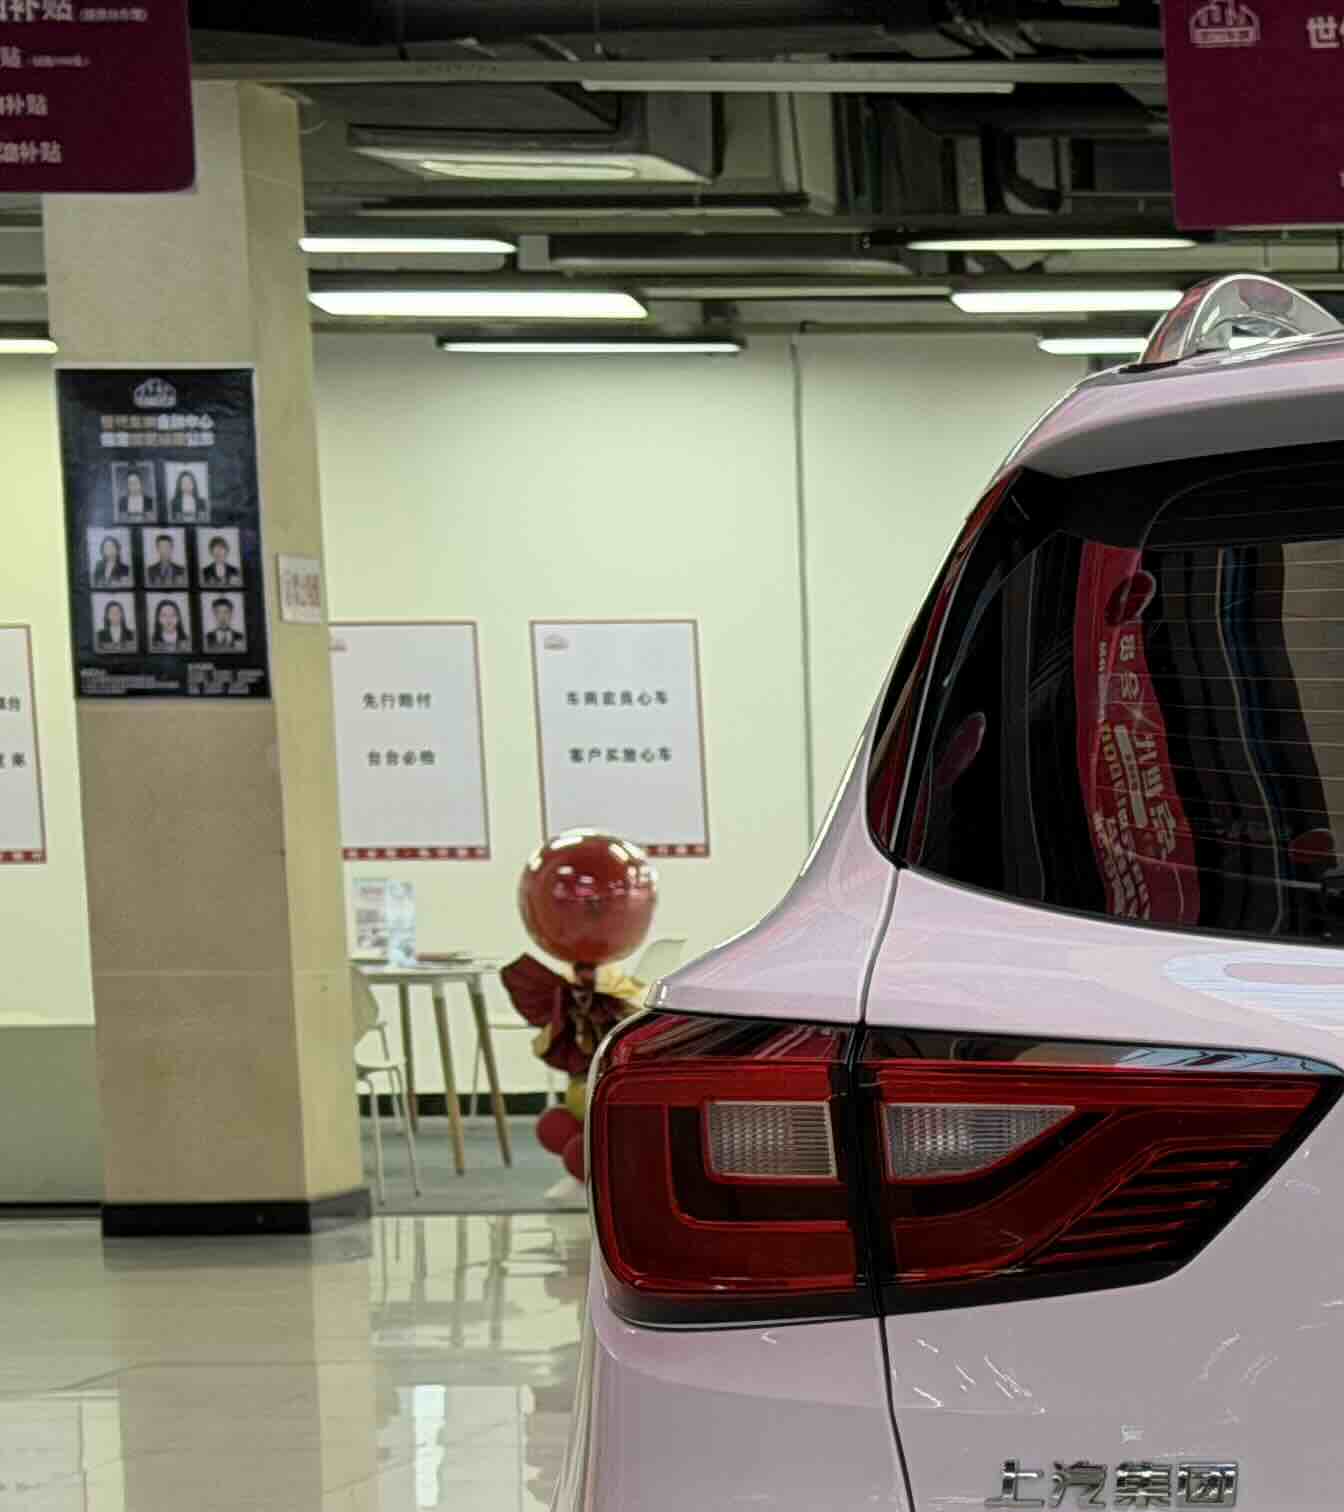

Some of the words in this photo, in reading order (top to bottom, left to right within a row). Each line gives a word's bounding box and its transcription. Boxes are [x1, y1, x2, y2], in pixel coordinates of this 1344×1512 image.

[0, 0, 73, 22] 补贴
[984, 1457, 1239, 1509] 上汽集团
